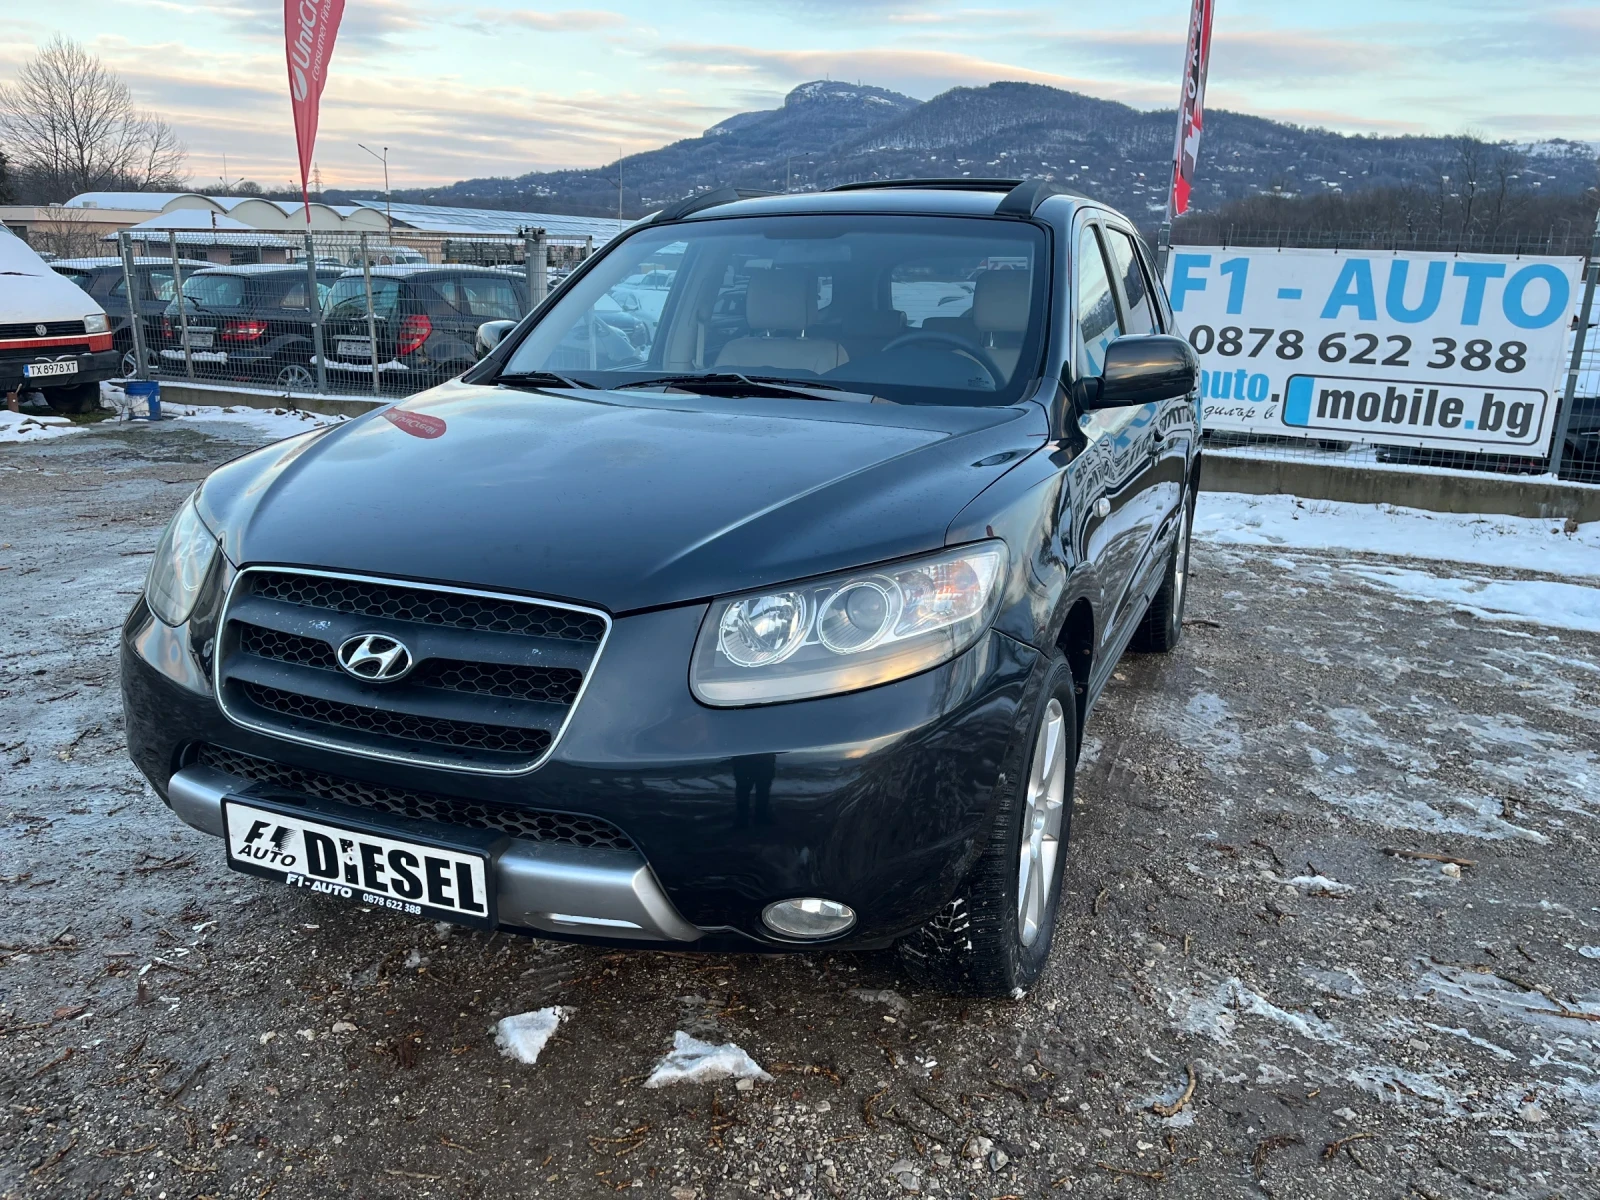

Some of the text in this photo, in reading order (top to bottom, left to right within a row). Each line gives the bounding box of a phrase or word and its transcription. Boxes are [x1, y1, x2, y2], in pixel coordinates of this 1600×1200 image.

[292, 0, 319, 69] UniCr
[1170, 254, 1249, 314] F1
[1320, 258, 1570, 329] AUTO
[30, 363, 76, 375] TX 8978 XT
[1189, 325, 1527, 374] 0878 622 388
[1316, 386, 1535, 439] mobile.bg
[238, 844, 296, 867] AUTO
[362, 893, 421, 915] 0878 622 388
